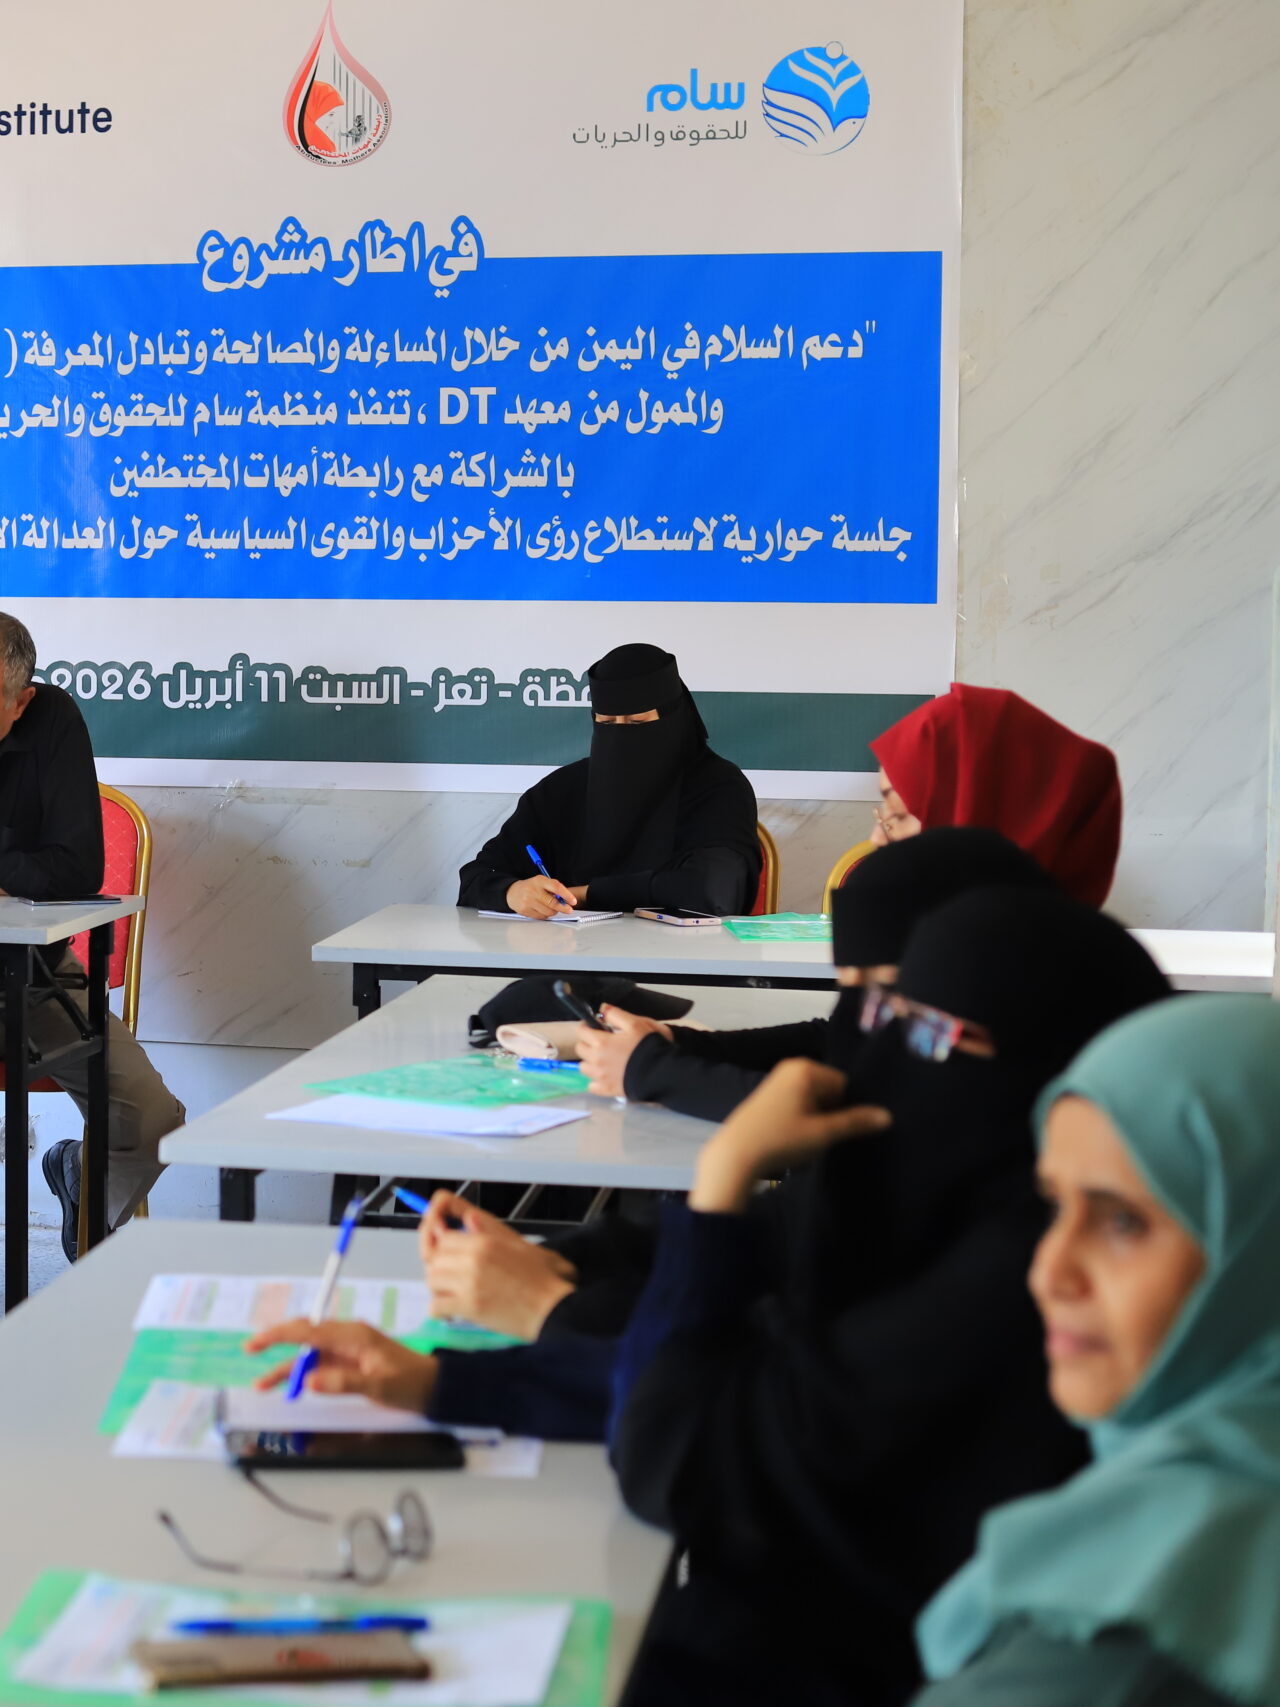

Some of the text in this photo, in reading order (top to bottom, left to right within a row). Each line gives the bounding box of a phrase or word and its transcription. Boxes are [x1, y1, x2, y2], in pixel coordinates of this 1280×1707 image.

[645, 68, 746, 112] سام
[572, 120, 748, 149] للحقوق والحريات
[202, 222, 326, 293] مشروع
[428, 221, 478, 298] في
[22, 330, 113, 377] المعرفة
[116, 328, 208, 377] وتبادل
[210, 328, 341, 374] والمصالحة
[343, 326, 447, 369] المساءلة
[450, 326, 520, 372] خلال
[529, 327, 569, 373] من
[577, 325, 656, 374] اليمن
[662, 322, 701, 380] في
[704, 324, 794, 370] السلام
[88, 391, 188, 438] للحقوق
[193, 393, 243, 437] سام
[245, 391, 338, 428] منظمة
[347, 387, 411, 425] تنفذ
[439, 386, 497, 426] DT
[503, 394, 571, 434] معهد
[579, 389, 620, 436] من
[626, 387, 724, 436] والممول
[110, 446, 575, 503] بالشراكة مع رابطة أمهات المختطفين
[20, 513, 116, 549] العدالة
[119, 515, 179, 560] حول
[184, 513, 307, 560] السياسية
[310, 515, 405, 561] والقوى
[409, 508, 522, 562] الأحزاب
[525, 515, 580, 563] رؤى
[583, 514, 718, 564] لاستطلاع
[721, 514, 824, 563] حوارية
[830, 514, 912, 562] جلسة
[162, 660, 244, 710] أبريل
[300, 673, 400, 712] السبت
[433, 674, 488, 711] تعز
